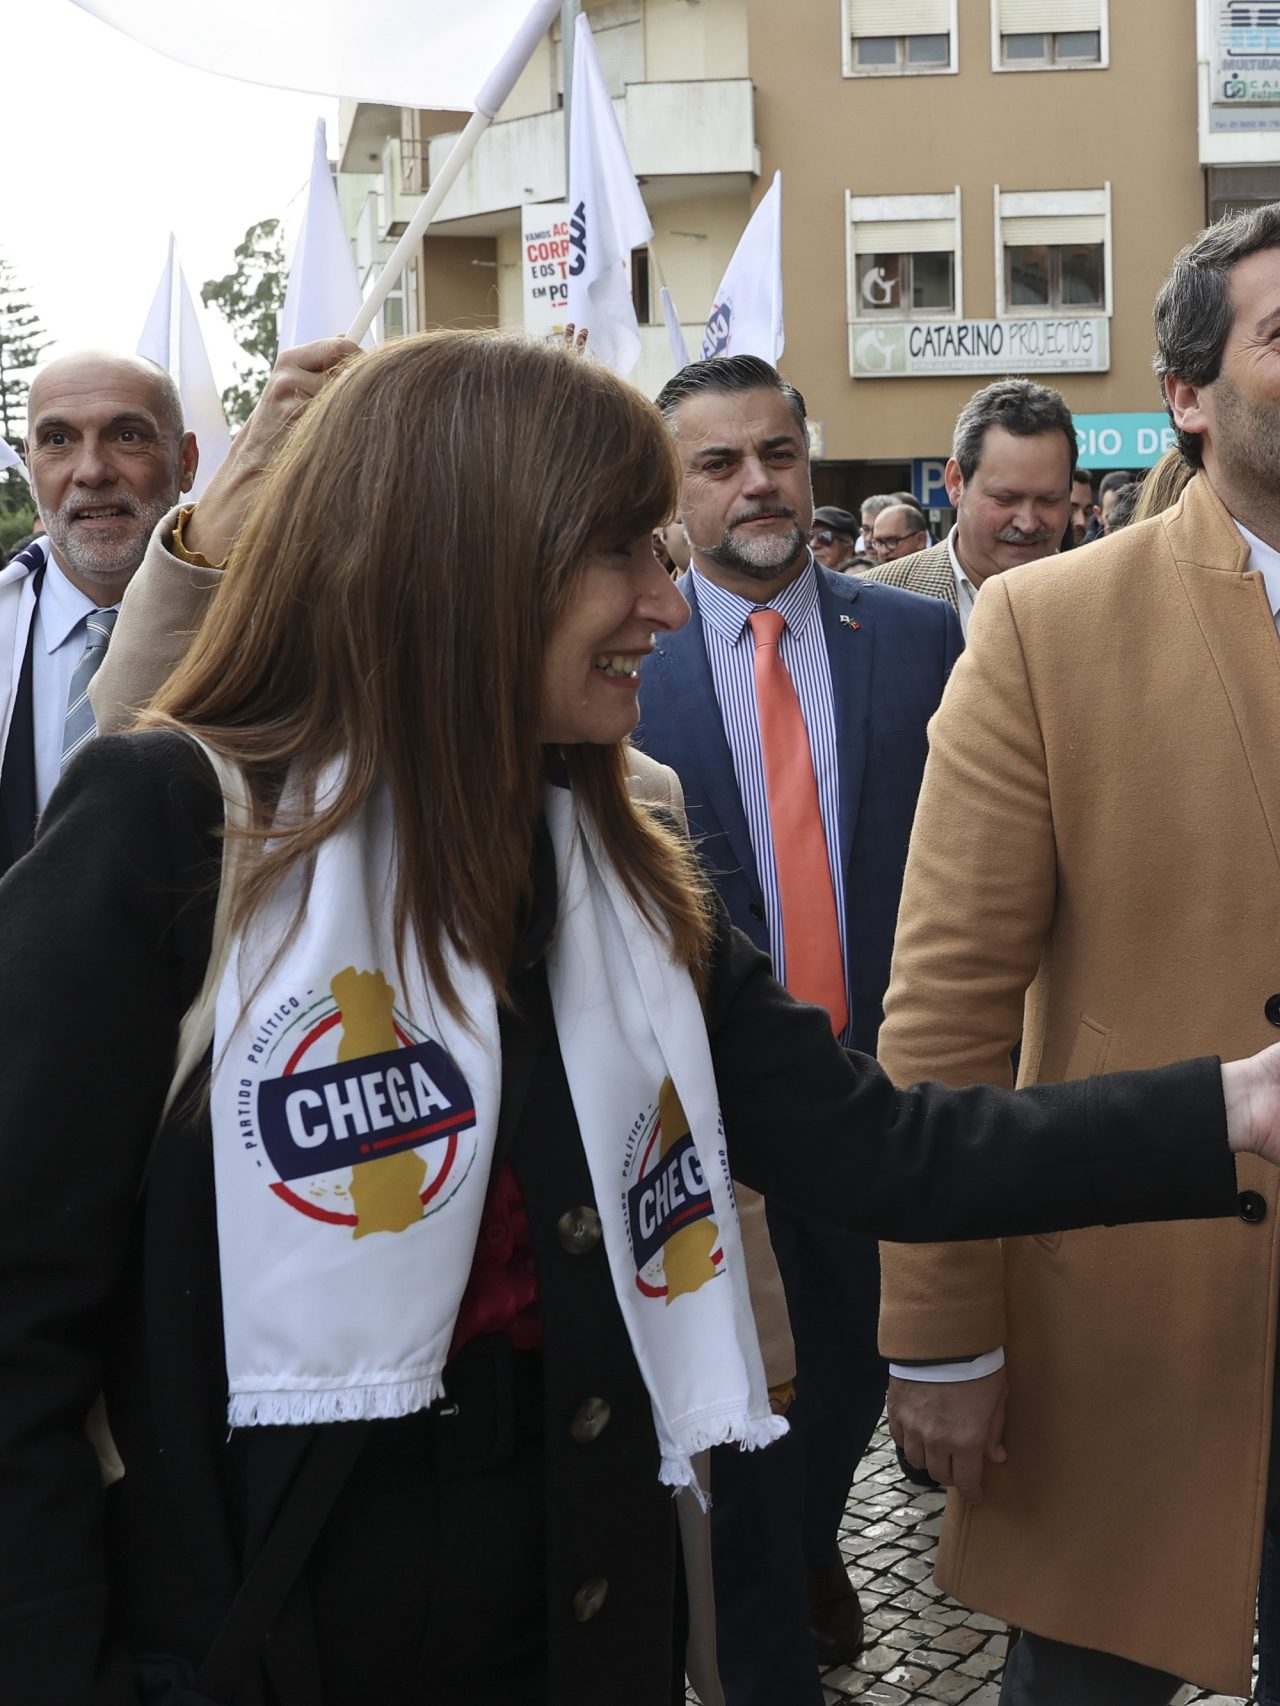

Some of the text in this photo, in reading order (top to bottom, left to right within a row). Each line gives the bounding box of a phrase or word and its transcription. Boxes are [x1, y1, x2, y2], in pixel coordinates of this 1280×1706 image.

[525, 230, 551, 242] VAMOS
[531, 265, 538, 279] E
[540, 263, 555, 277] OS
[532, 286, 547, 298] EM
[909, 320, 1094, 358] CATARINO PROJECTOS
[921, 462, 944, 505] P
[238, 1078, 258, 1149] PARTIDO
[285, 1061, 452, 1149] CHEGA
